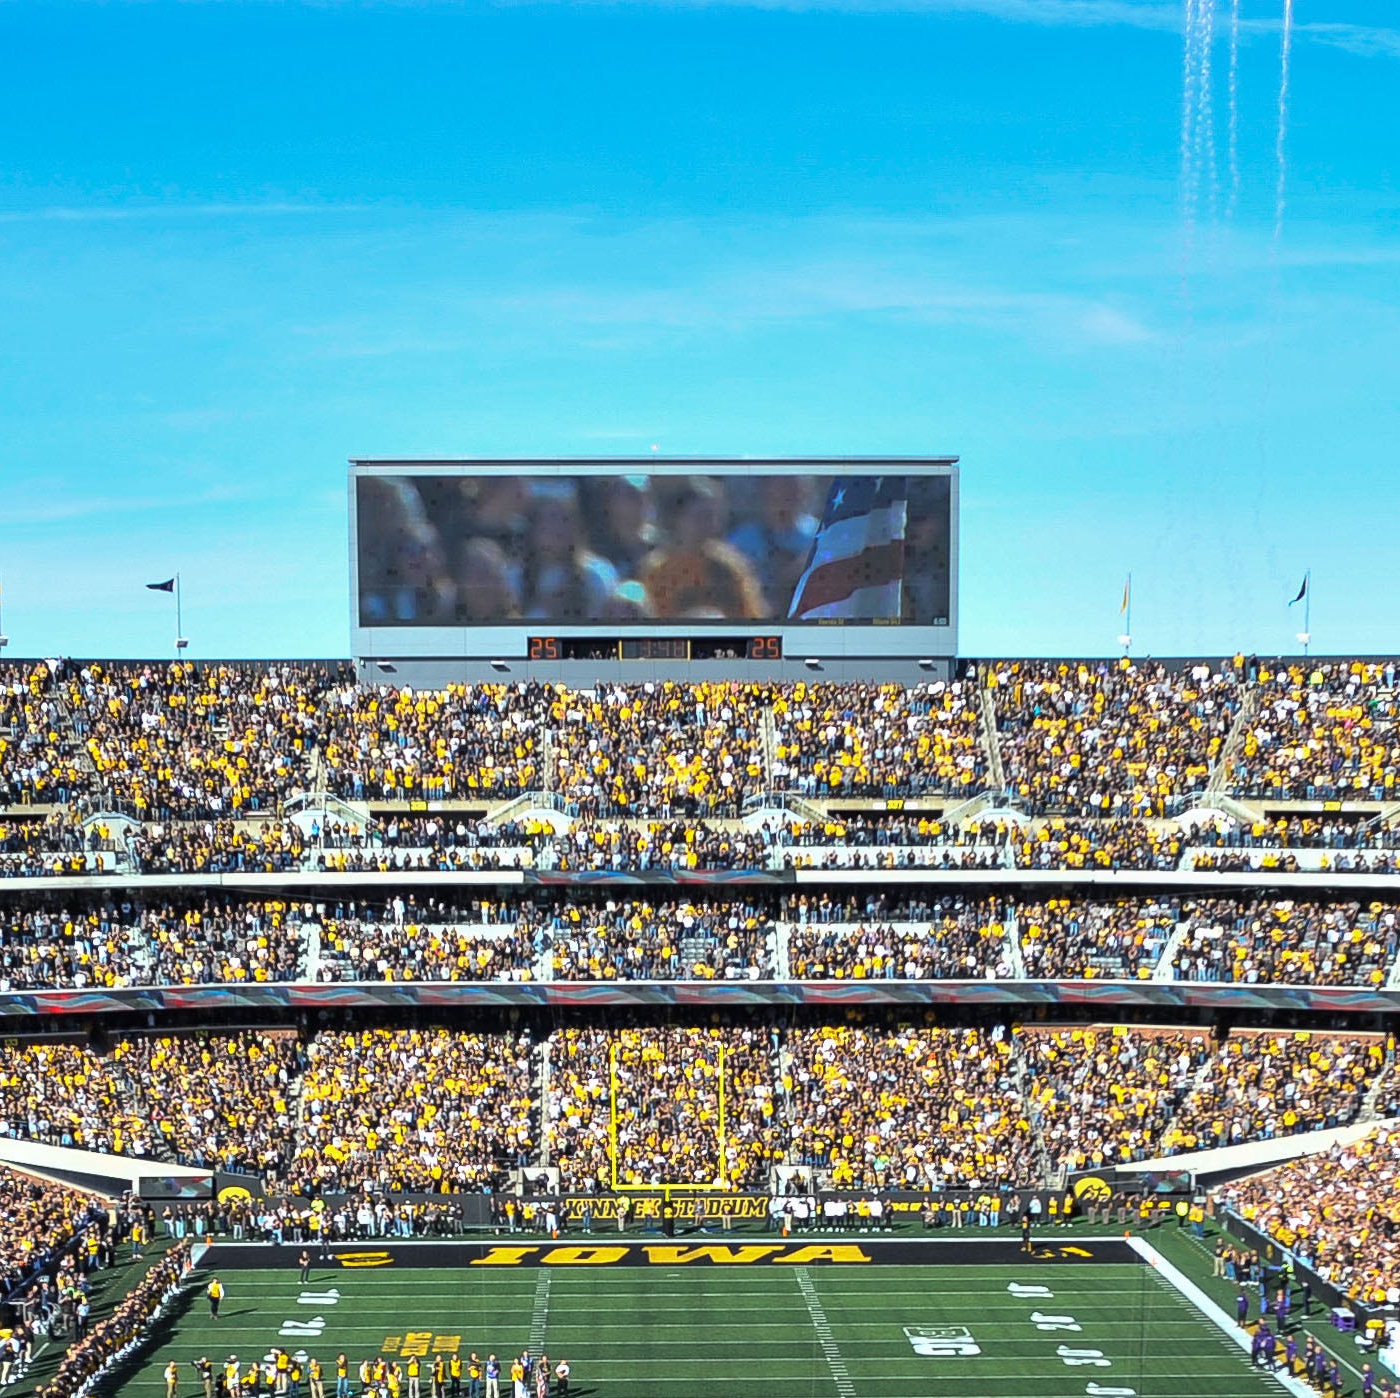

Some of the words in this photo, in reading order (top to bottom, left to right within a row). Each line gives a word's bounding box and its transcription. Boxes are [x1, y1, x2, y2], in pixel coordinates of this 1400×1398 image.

[531, 638, 558, 659] 25
[752, 638, 779, 659] 25
[566, 1198, 661, 1219] KNNCK
[667, 1198, 768, 1219] STADUM
[470, 1245, 871, 1264] IOWA
[1030, 1315, 1082, 1331] 20
